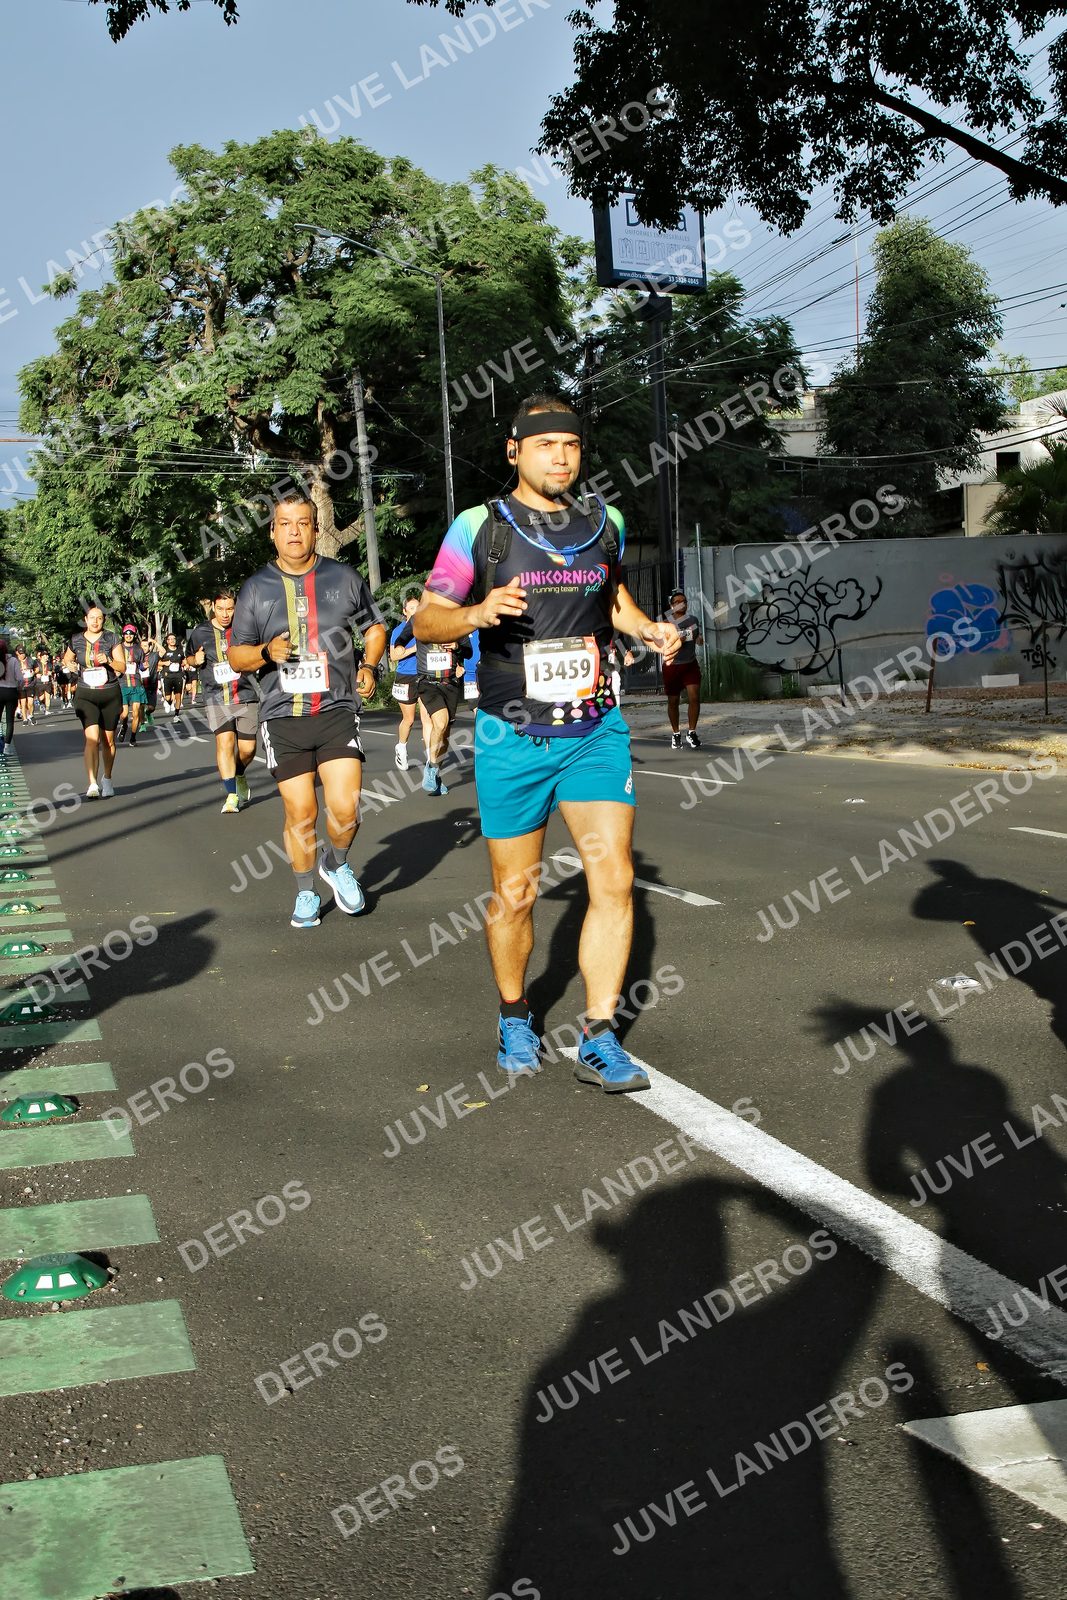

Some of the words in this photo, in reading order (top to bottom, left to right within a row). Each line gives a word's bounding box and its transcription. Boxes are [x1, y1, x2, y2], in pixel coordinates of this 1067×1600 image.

[532, 586, 560, 595] running
[560, 585, 579, 593] team
[429, 655, 447, 663] 9844
[282, 665, 322, 680] 13215
[529, 657, 592, 683] 13459
